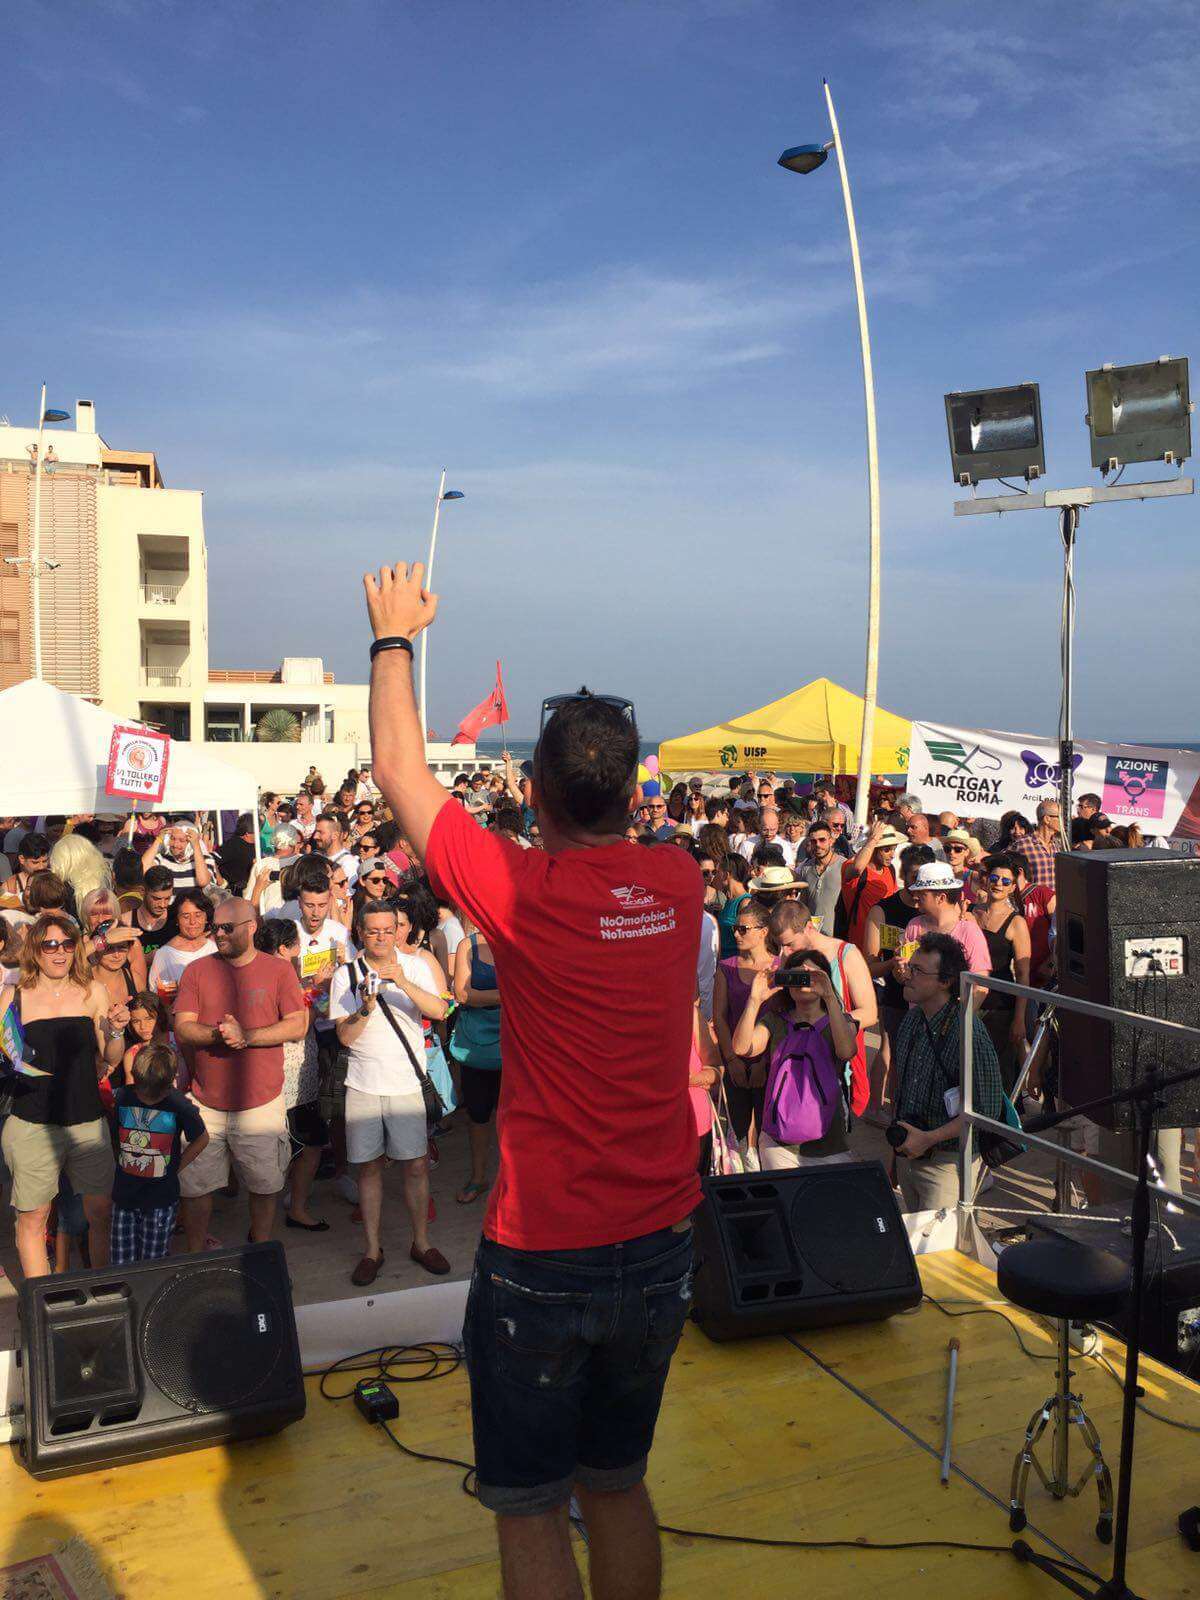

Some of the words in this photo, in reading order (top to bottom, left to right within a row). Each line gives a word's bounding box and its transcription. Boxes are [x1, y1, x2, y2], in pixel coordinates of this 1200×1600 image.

[744, 747, 767, 757] UISP
[1115, 760, 1159, 772] AZIONE
[919, 773, 1002, 793] ARCIGAY
[956, 790, 1003, 805] ROMA
[1115, 805, 1150, 816] TRANS
[600, 907, 675, 927] NoOmofobia.it
[600, 919, 676, 939] NoTransfobia.it
